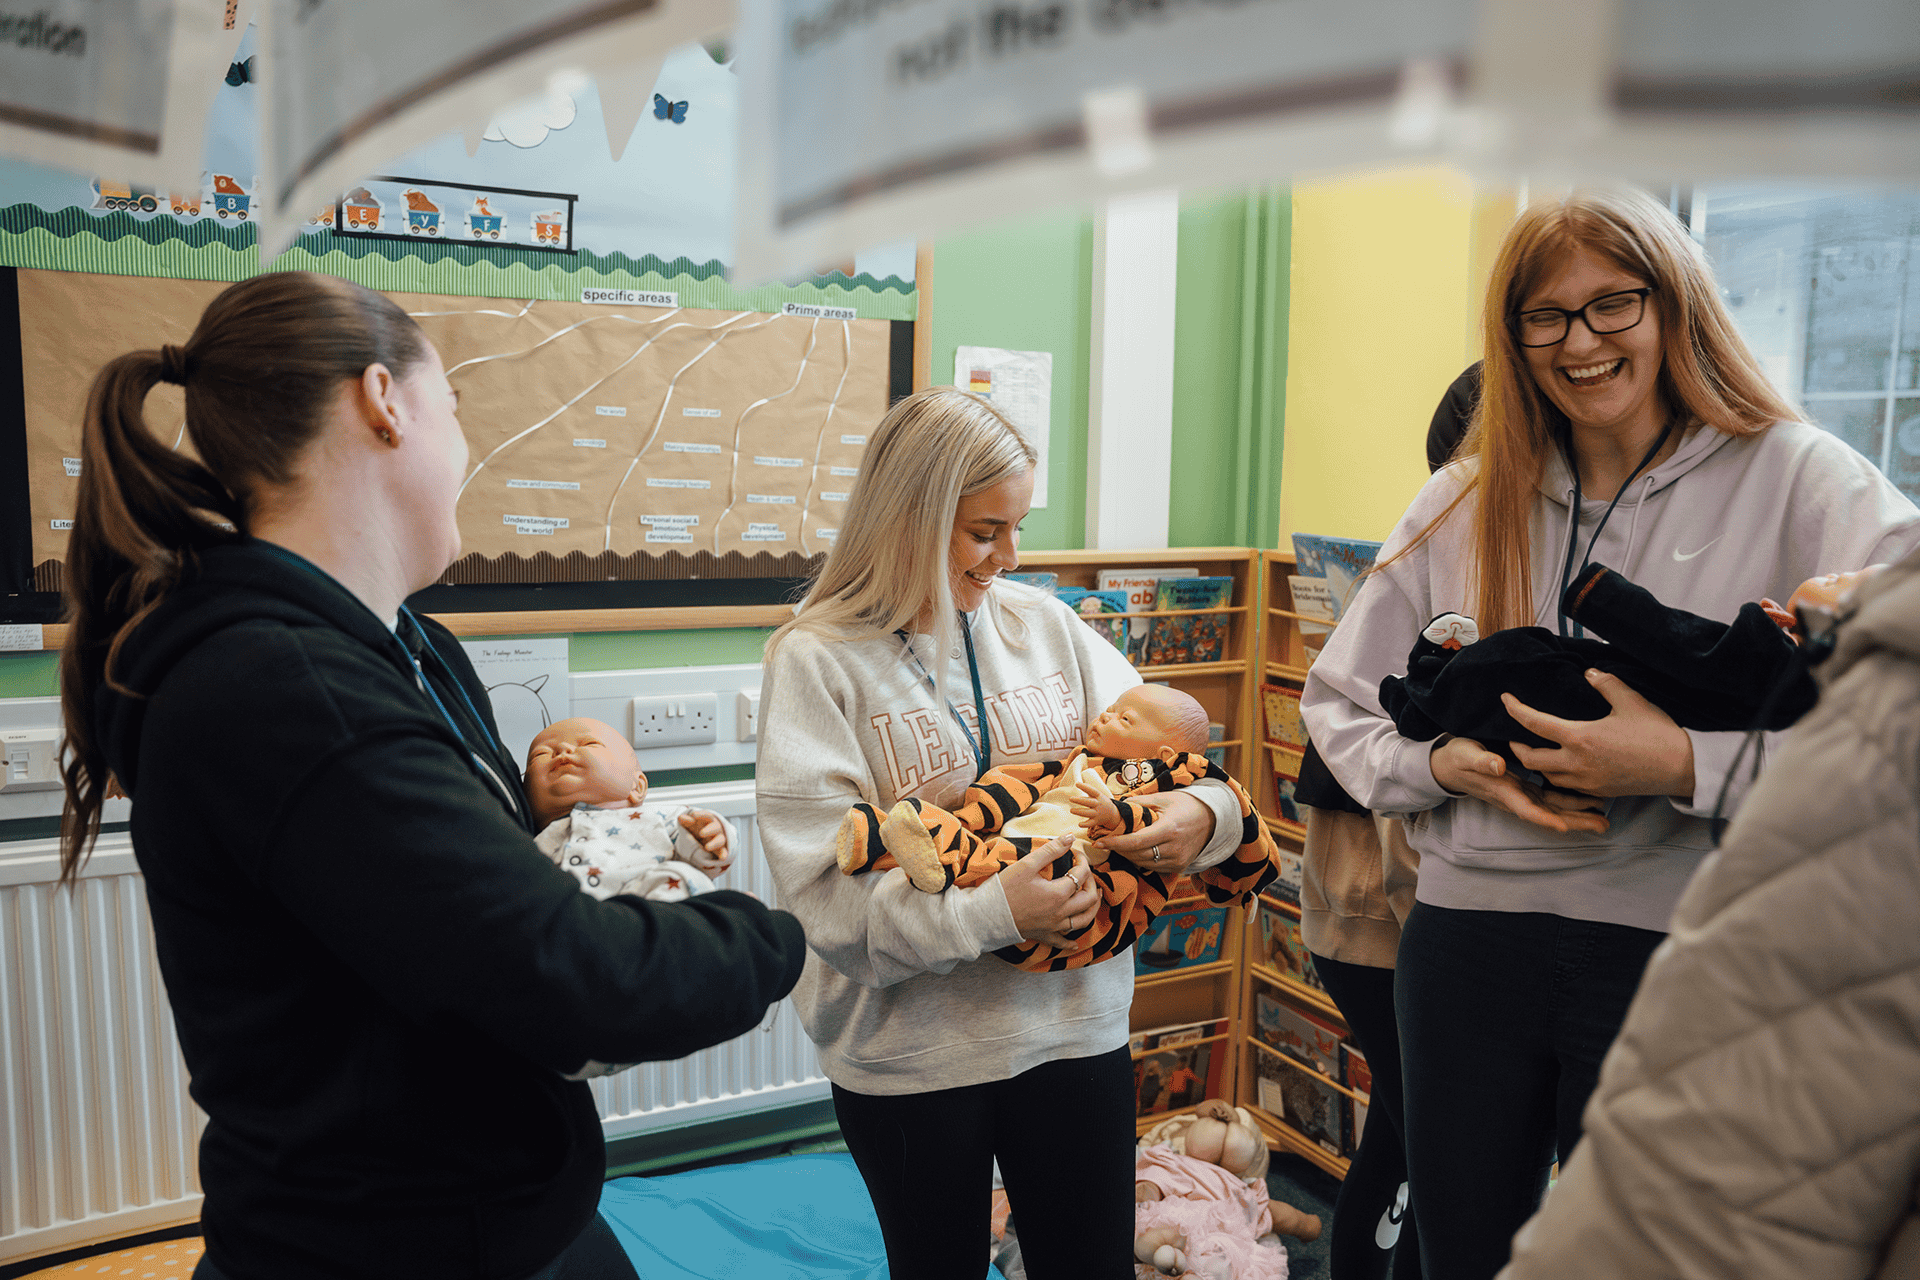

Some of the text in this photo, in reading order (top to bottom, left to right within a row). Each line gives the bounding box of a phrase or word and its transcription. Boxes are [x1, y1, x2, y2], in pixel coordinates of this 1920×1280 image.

[227, 198, 237, 209] B
[359, 209, 367, 221] E
[484, 219, 491, 231] F
[545, 225, 553, 236] S
[583, 290, 672, 304] specific areas
[787, 303, 854, 320] Prime areas
[507, 480, 528, 488] People
[541, 481, 579, 490] communities
[504, 516, 558, 527] Understanding
[642, 516, 671, 524] Personal
[672, 516, 692, 524] social
[532, 527, 553, 535] world
[750, 524, 778, 533] Physical
[647, 533, 692, 543] development
[743, 532, 785, 541] development
[1108, 579, 1155, 589] My Friends
